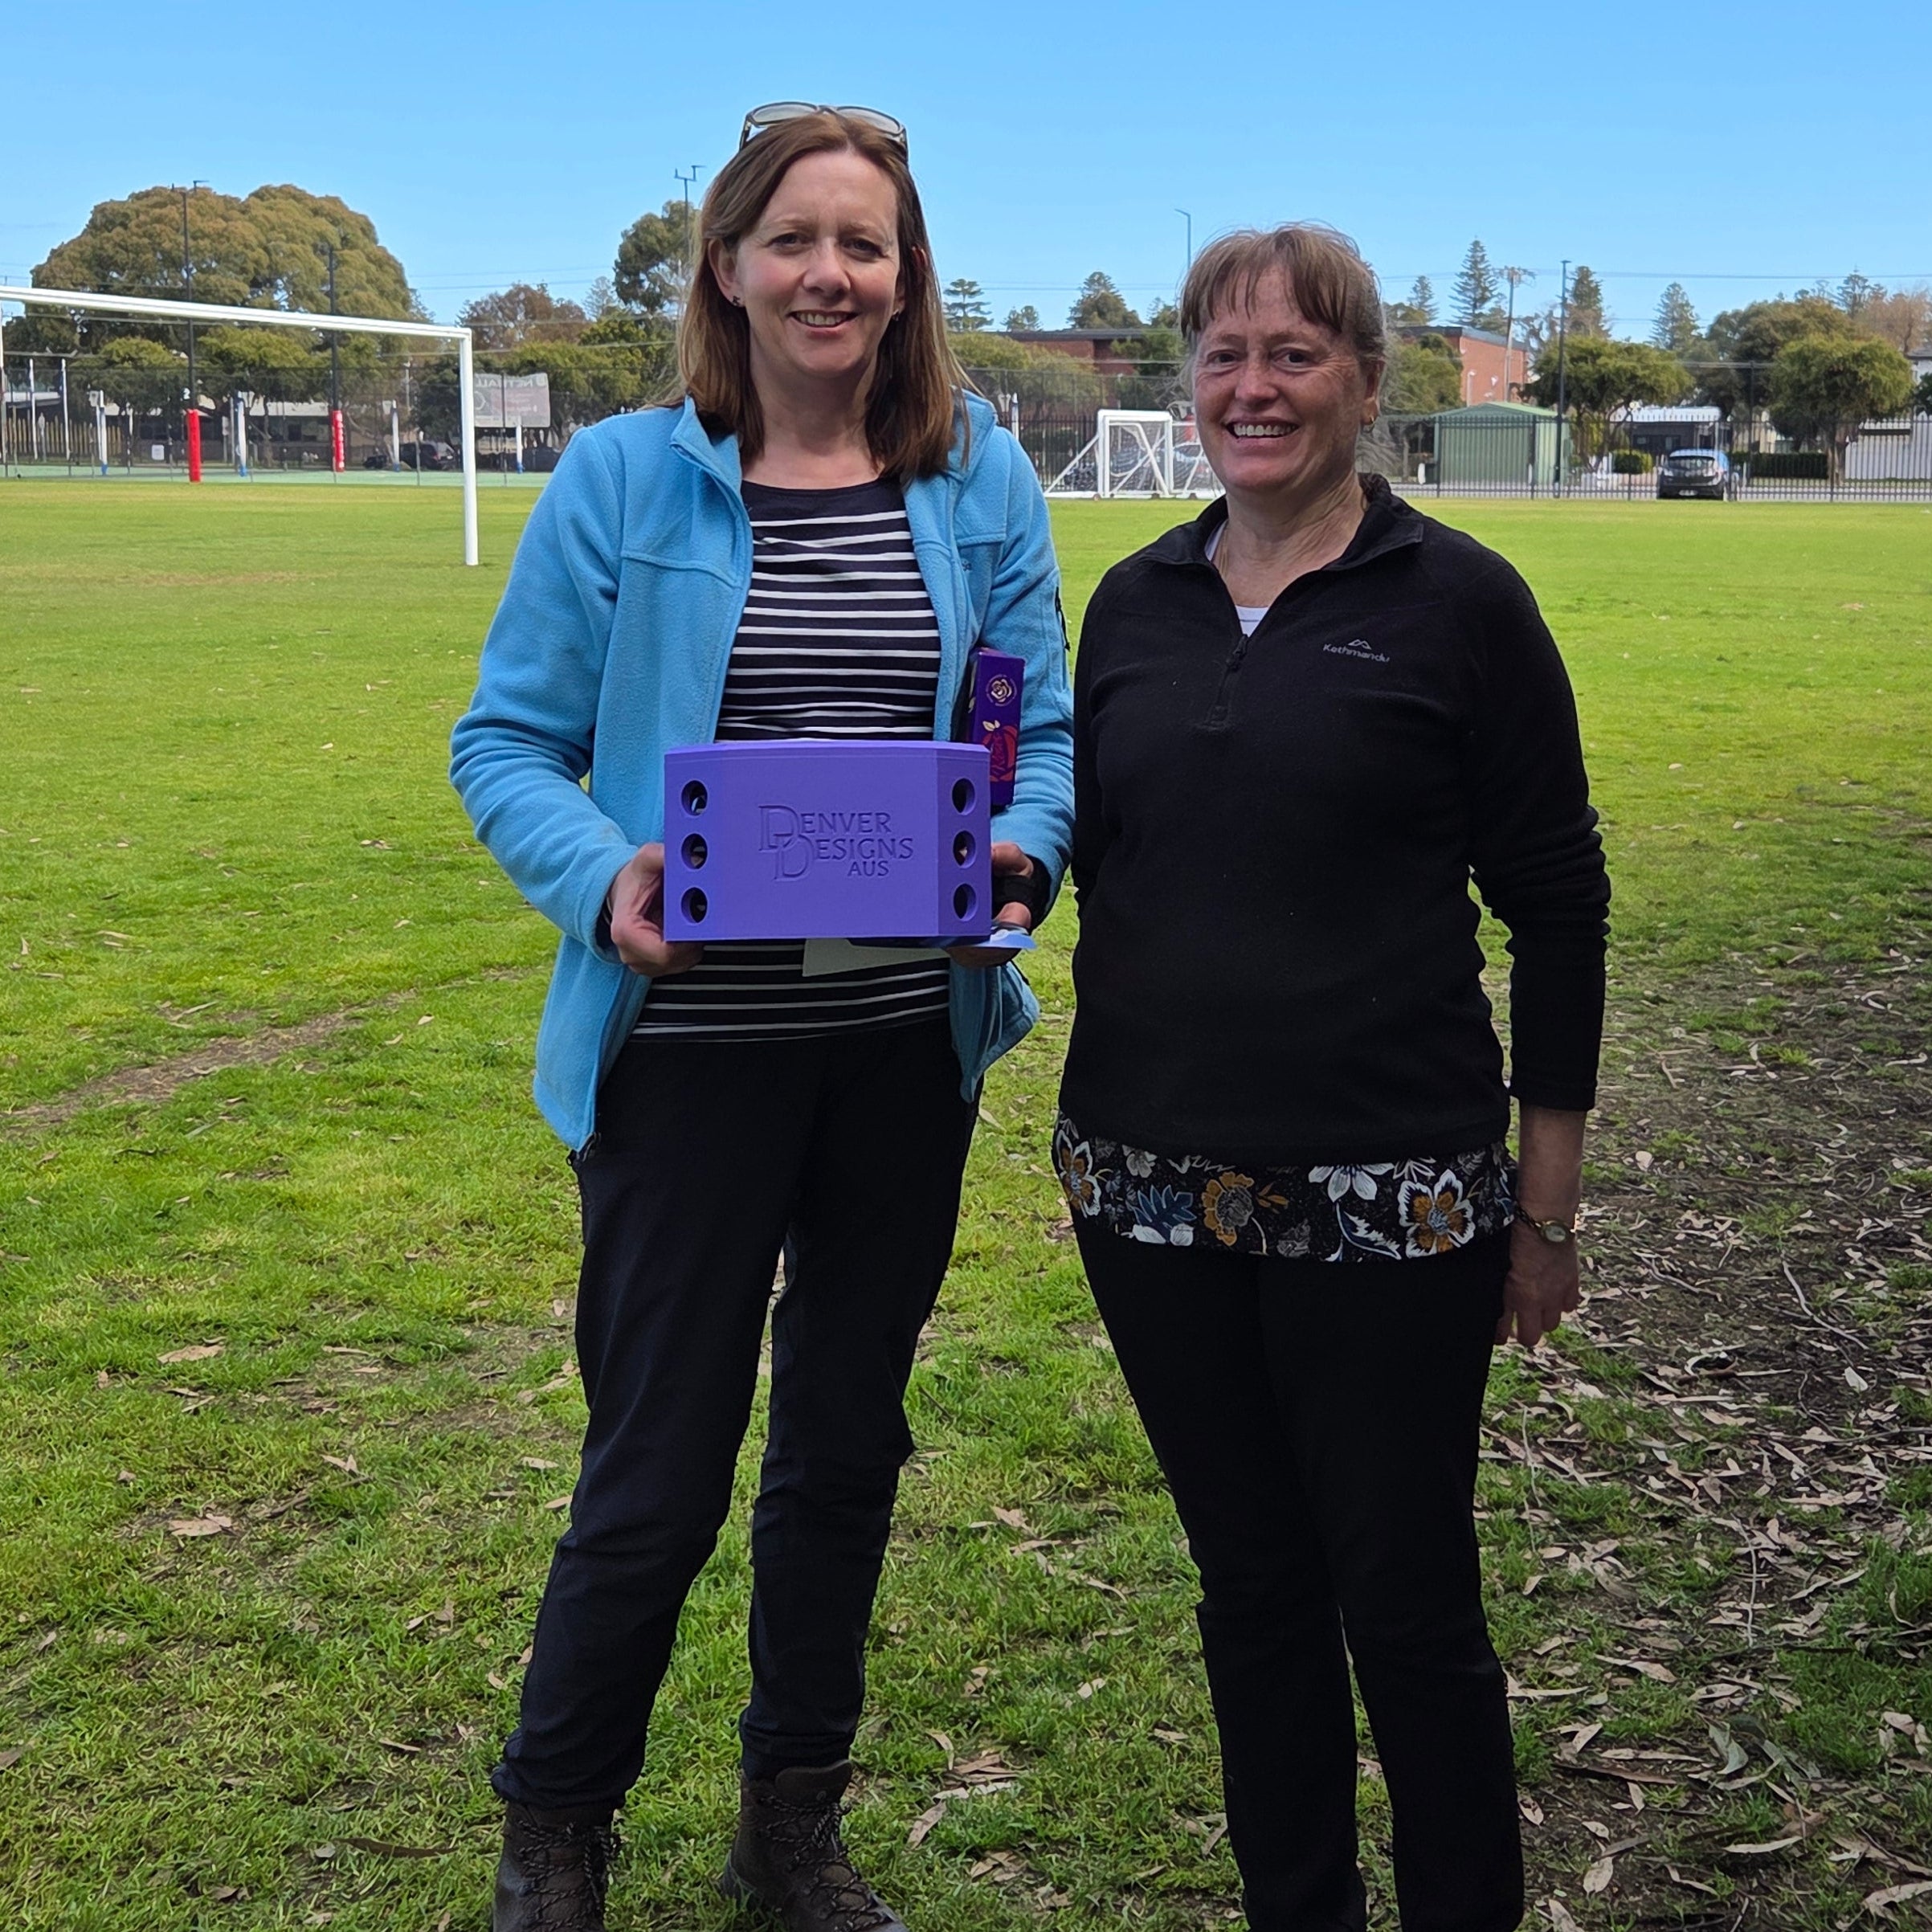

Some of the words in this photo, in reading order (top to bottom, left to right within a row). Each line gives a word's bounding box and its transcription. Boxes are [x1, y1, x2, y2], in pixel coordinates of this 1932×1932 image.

[758, 805, 892, 852] DENVER
[774, 834, 913, 881] DESIGNS
[848, 860, 889, 876] AUS
